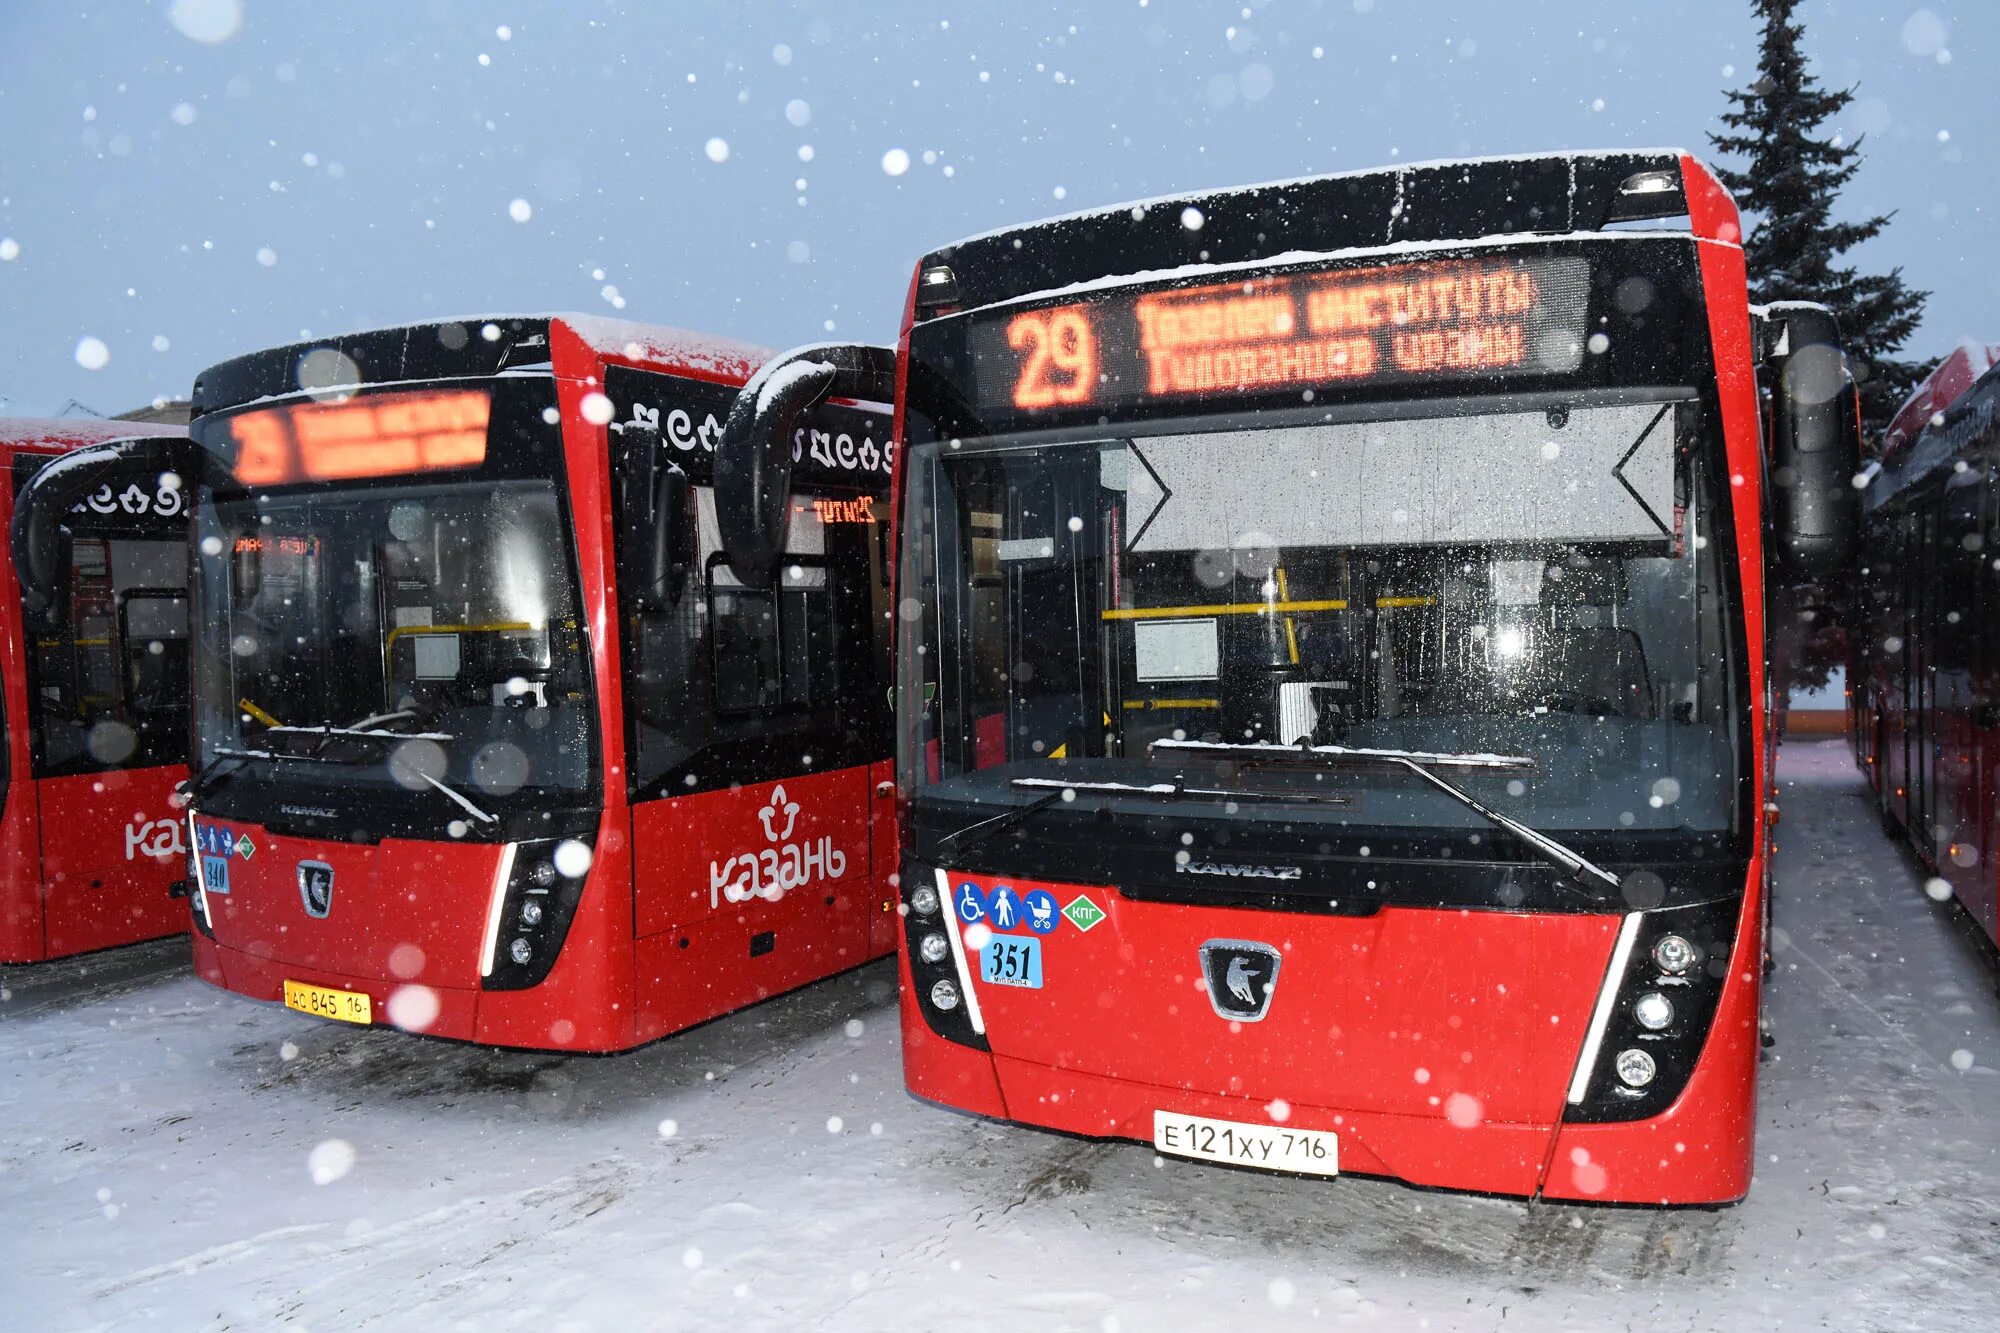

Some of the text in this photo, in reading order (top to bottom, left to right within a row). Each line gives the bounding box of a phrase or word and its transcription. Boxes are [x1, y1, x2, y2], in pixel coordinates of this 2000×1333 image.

[1008, 307, 1095, 407] 29
[207, 862, 225, 888] 340
[1176, 861, 1301, 879] KAMAZ
[1072, 906, 1096, 919] КПГ
[990, 942, 1030, 980] 351
[347, 997, 361, 1012] 16
[1282, 1134, 1326, 1159] 716
